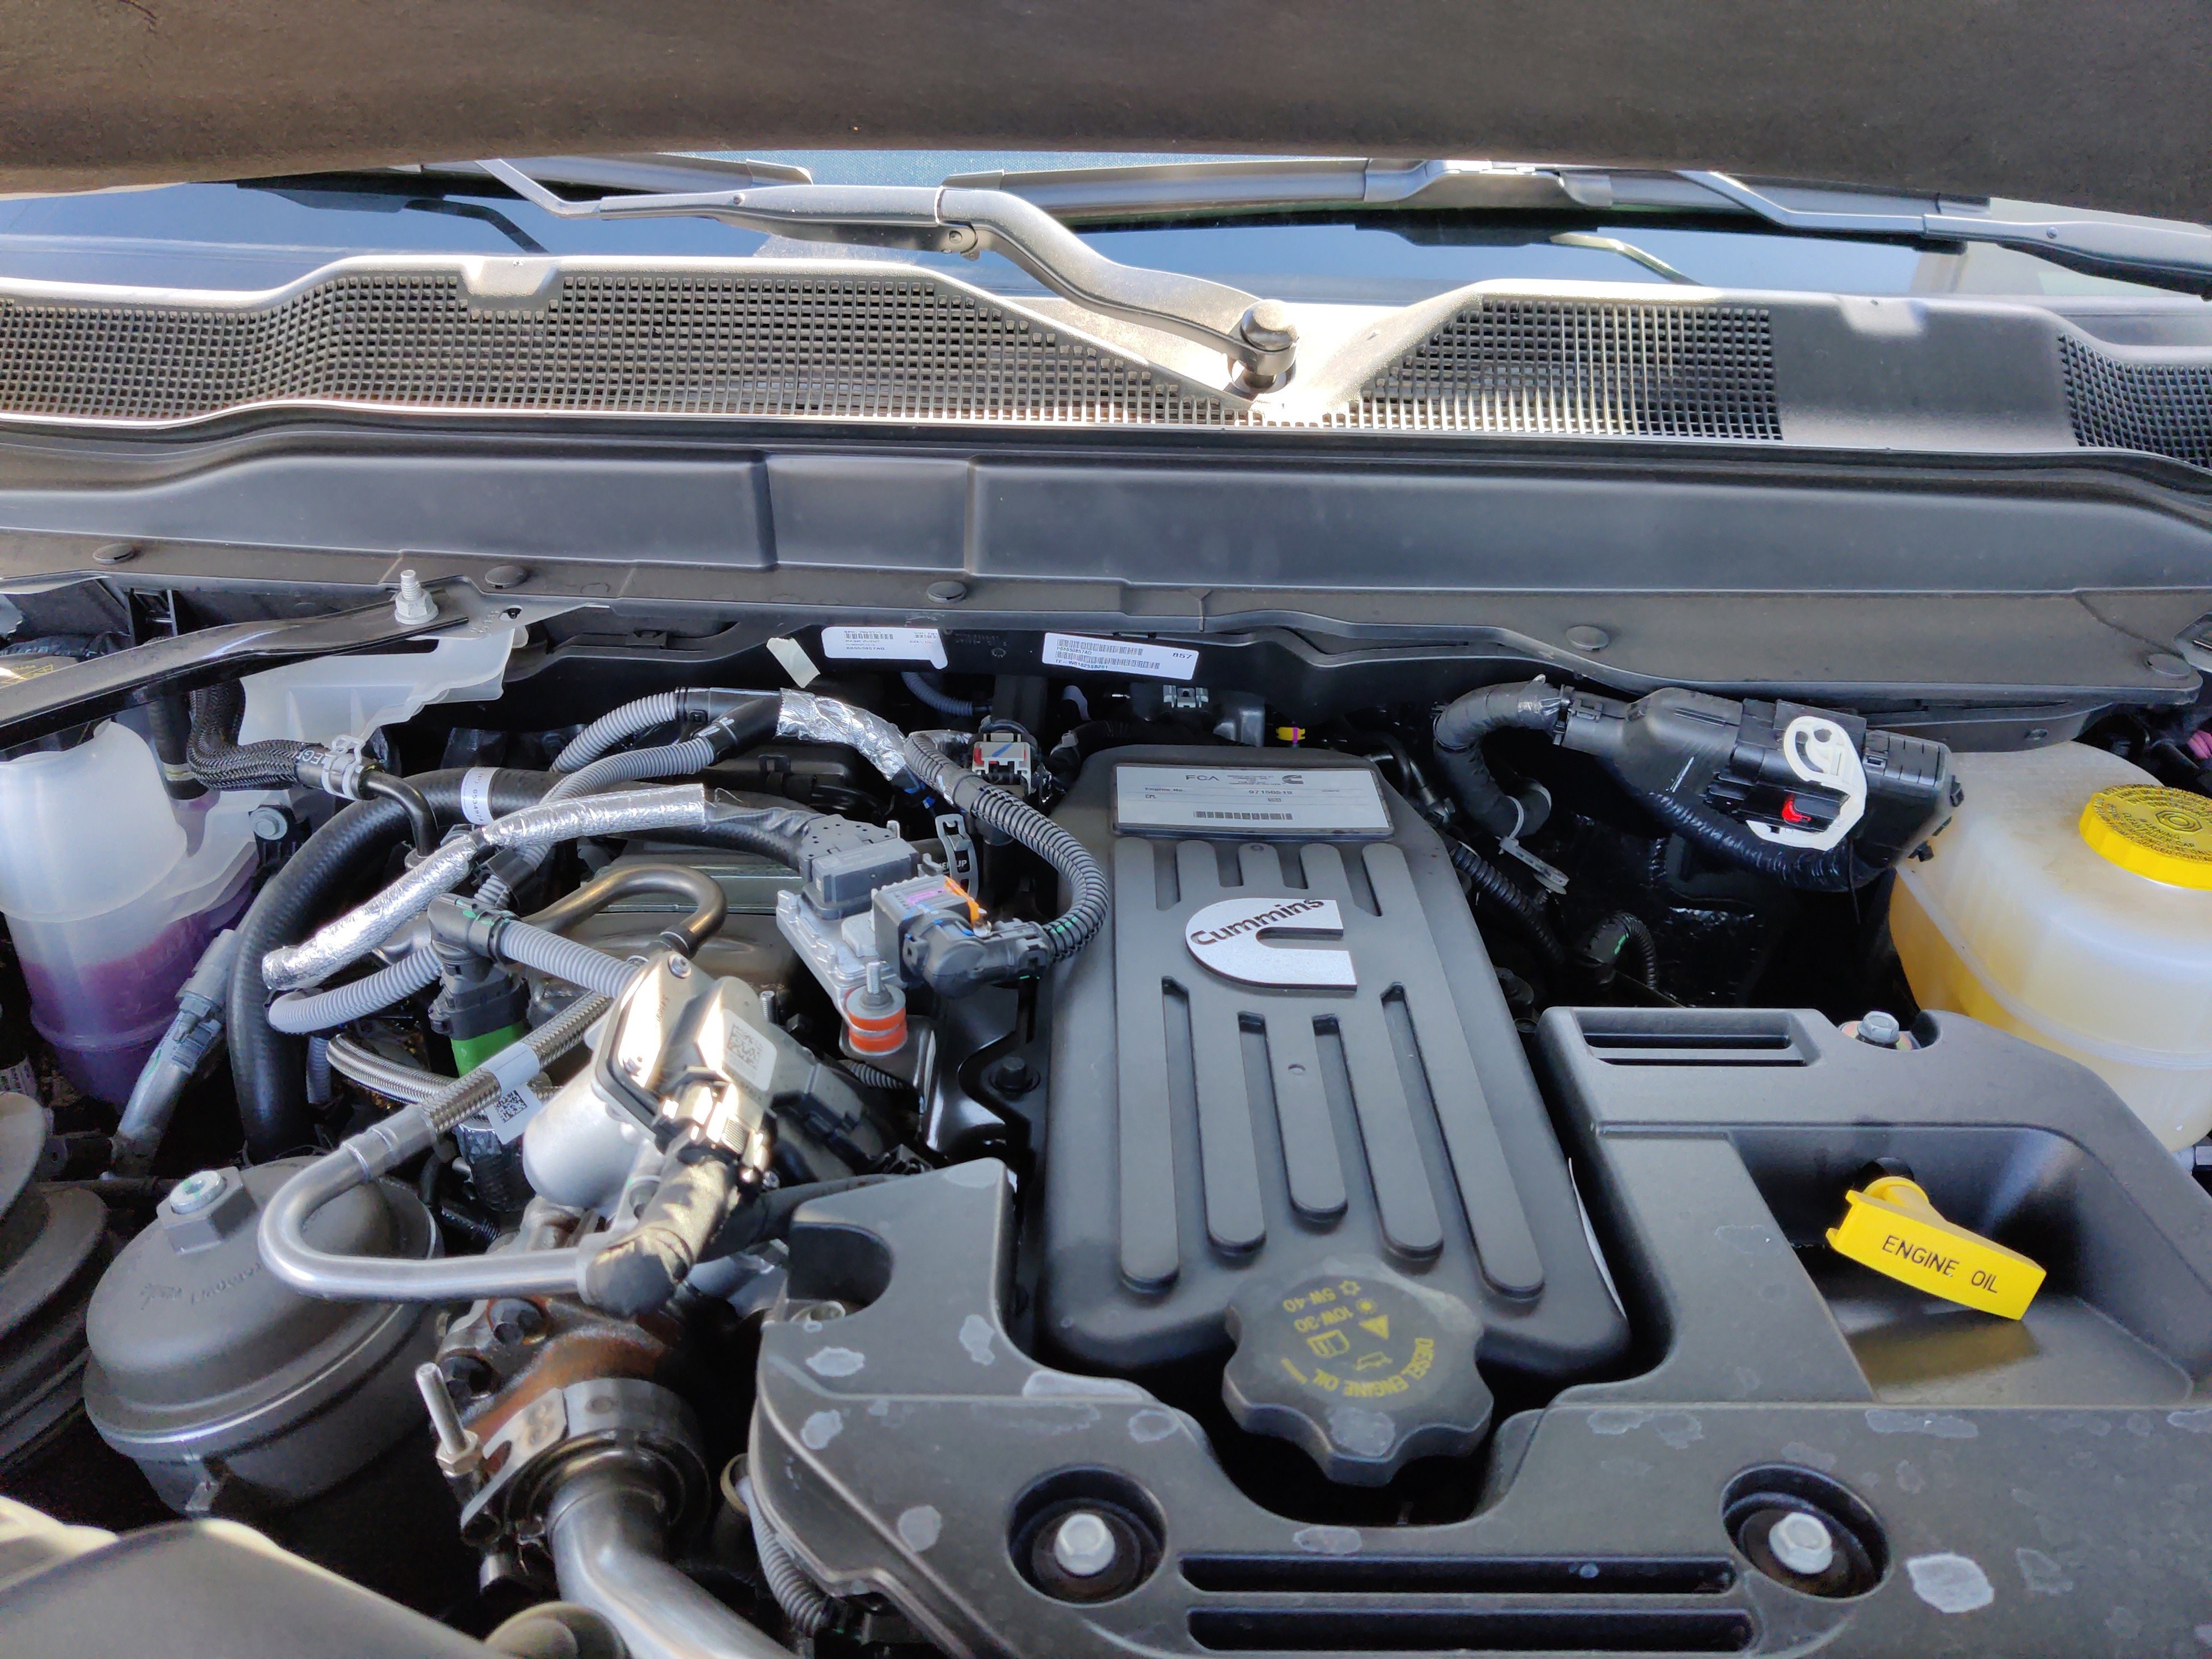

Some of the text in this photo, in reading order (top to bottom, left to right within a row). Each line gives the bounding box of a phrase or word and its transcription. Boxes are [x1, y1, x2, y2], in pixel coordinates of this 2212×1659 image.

[1190, 899, 1325, 946] Cummins
[1881, 1234, 1999, 1294] ENGINE OIL
[1282, 1287, 1337, 1313] 5W-40
[1293, 1305, 1354, 1333] 10W-30
[1312, 1337, 1434, 1397] DIESEL ENGINE OIL
